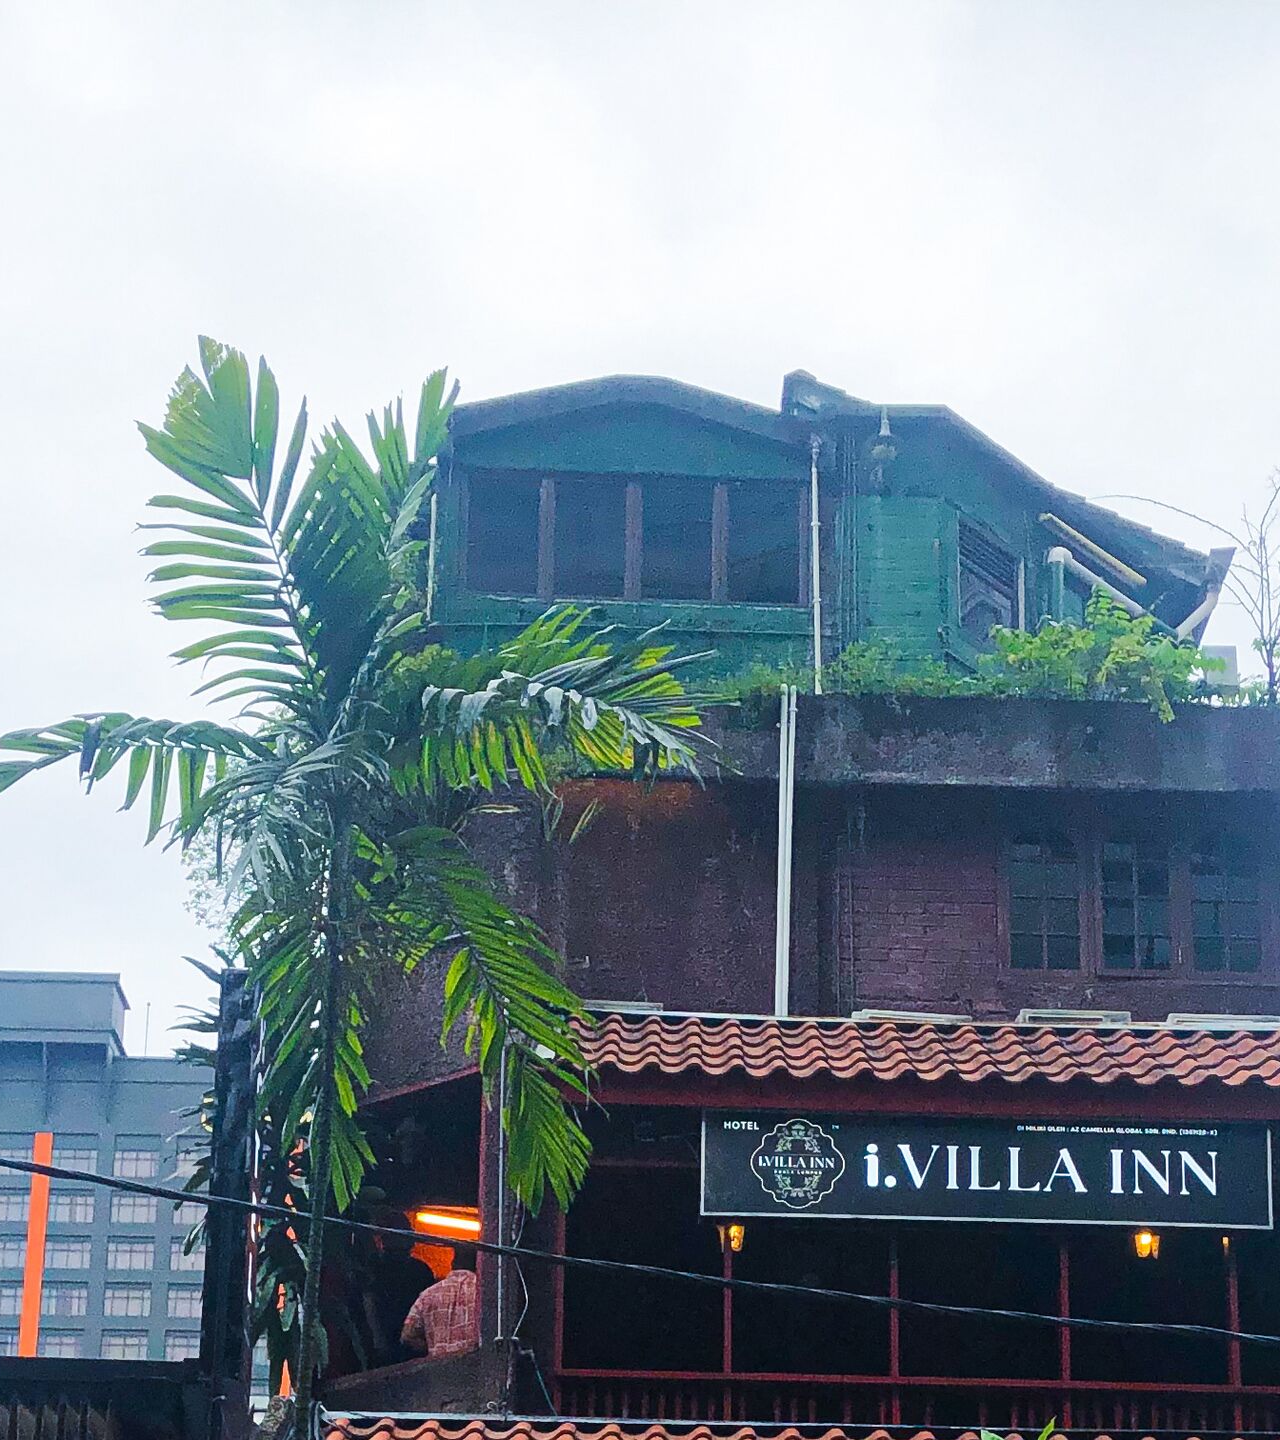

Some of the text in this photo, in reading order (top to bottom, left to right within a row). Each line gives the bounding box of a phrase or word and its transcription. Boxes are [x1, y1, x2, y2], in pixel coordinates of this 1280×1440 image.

[723, 1121, 759, 1130] HOTEL
[809, 1157, 835, 1169] INN
[864, 1143, 1218, 1197] i.VILLA INN
